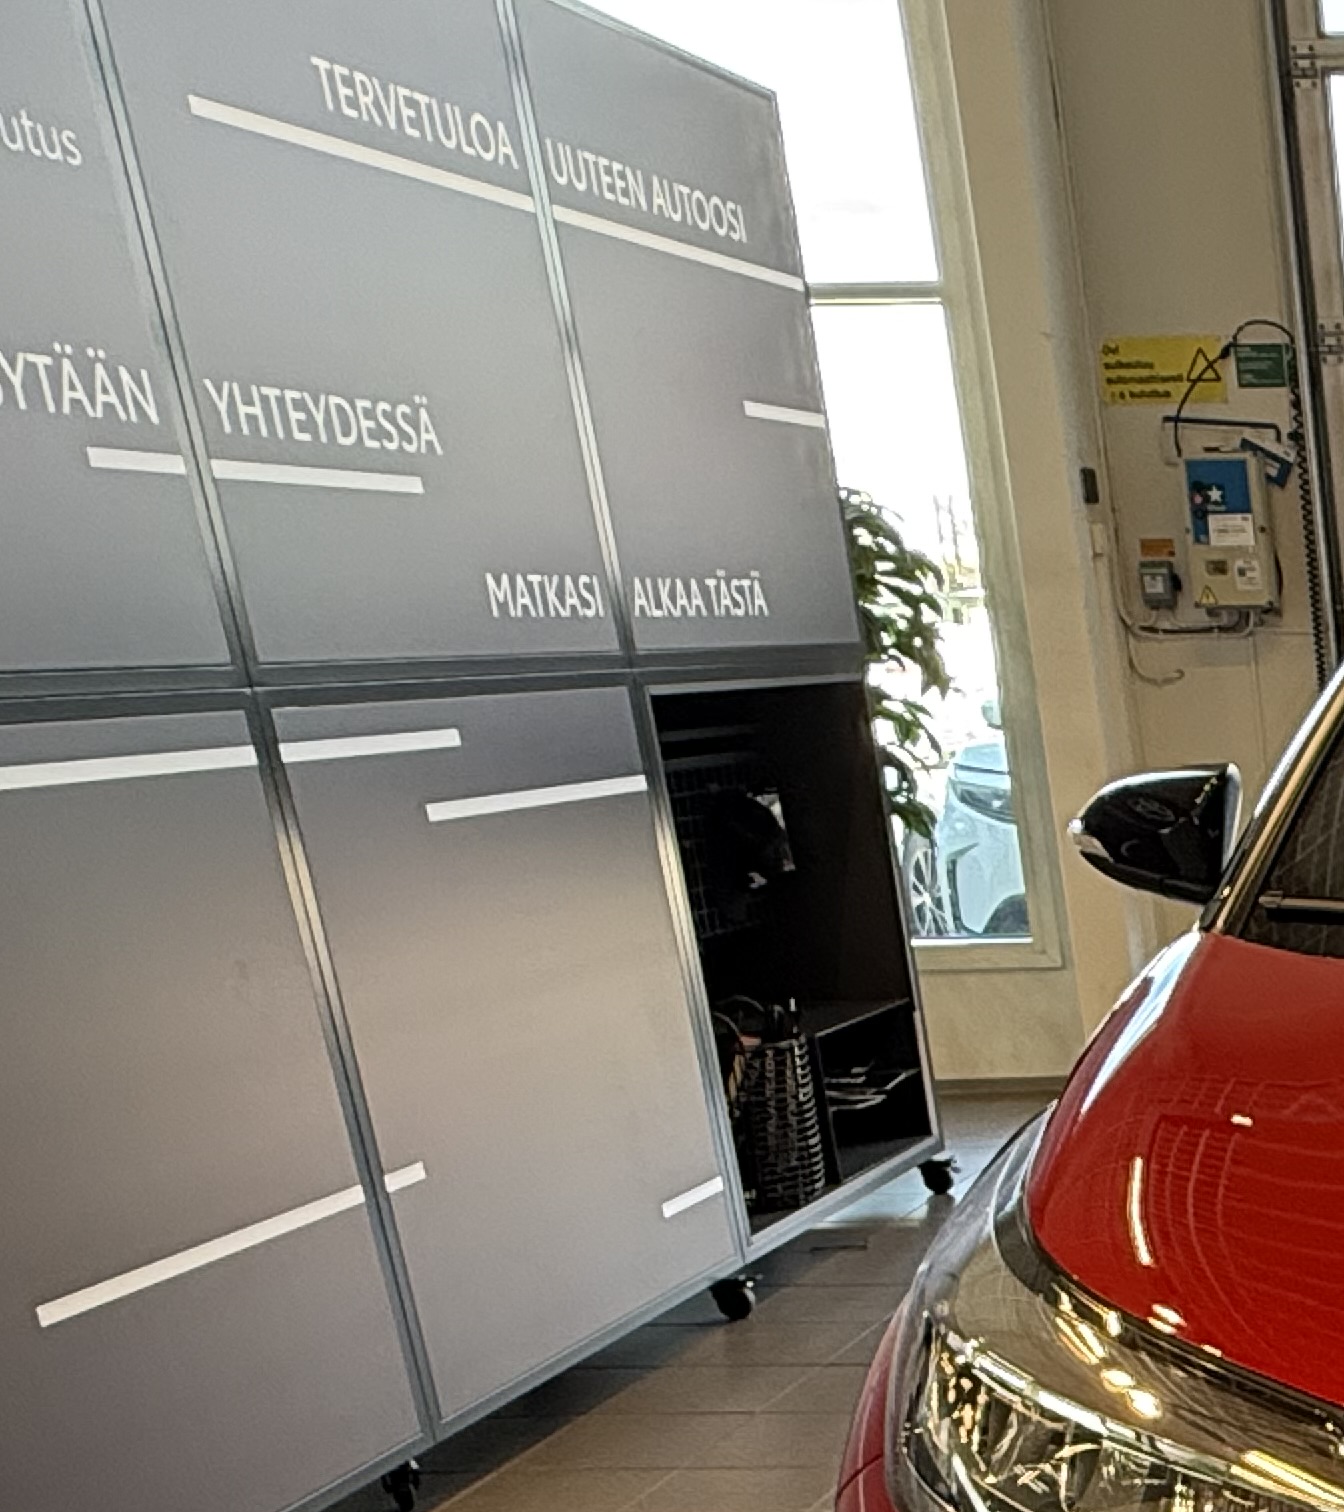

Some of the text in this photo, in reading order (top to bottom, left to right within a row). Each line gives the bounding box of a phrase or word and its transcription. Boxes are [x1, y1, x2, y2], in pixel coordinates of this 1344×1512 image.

[310, 56, 748, 244] TERVETULOA UUTEEN AUTOOSI
[0, 341, 443, 456] YTÄÄN YHTEYDESSÄ
[485, 568, 769, 618] MATKASI ALKAA TÄSTÄ
